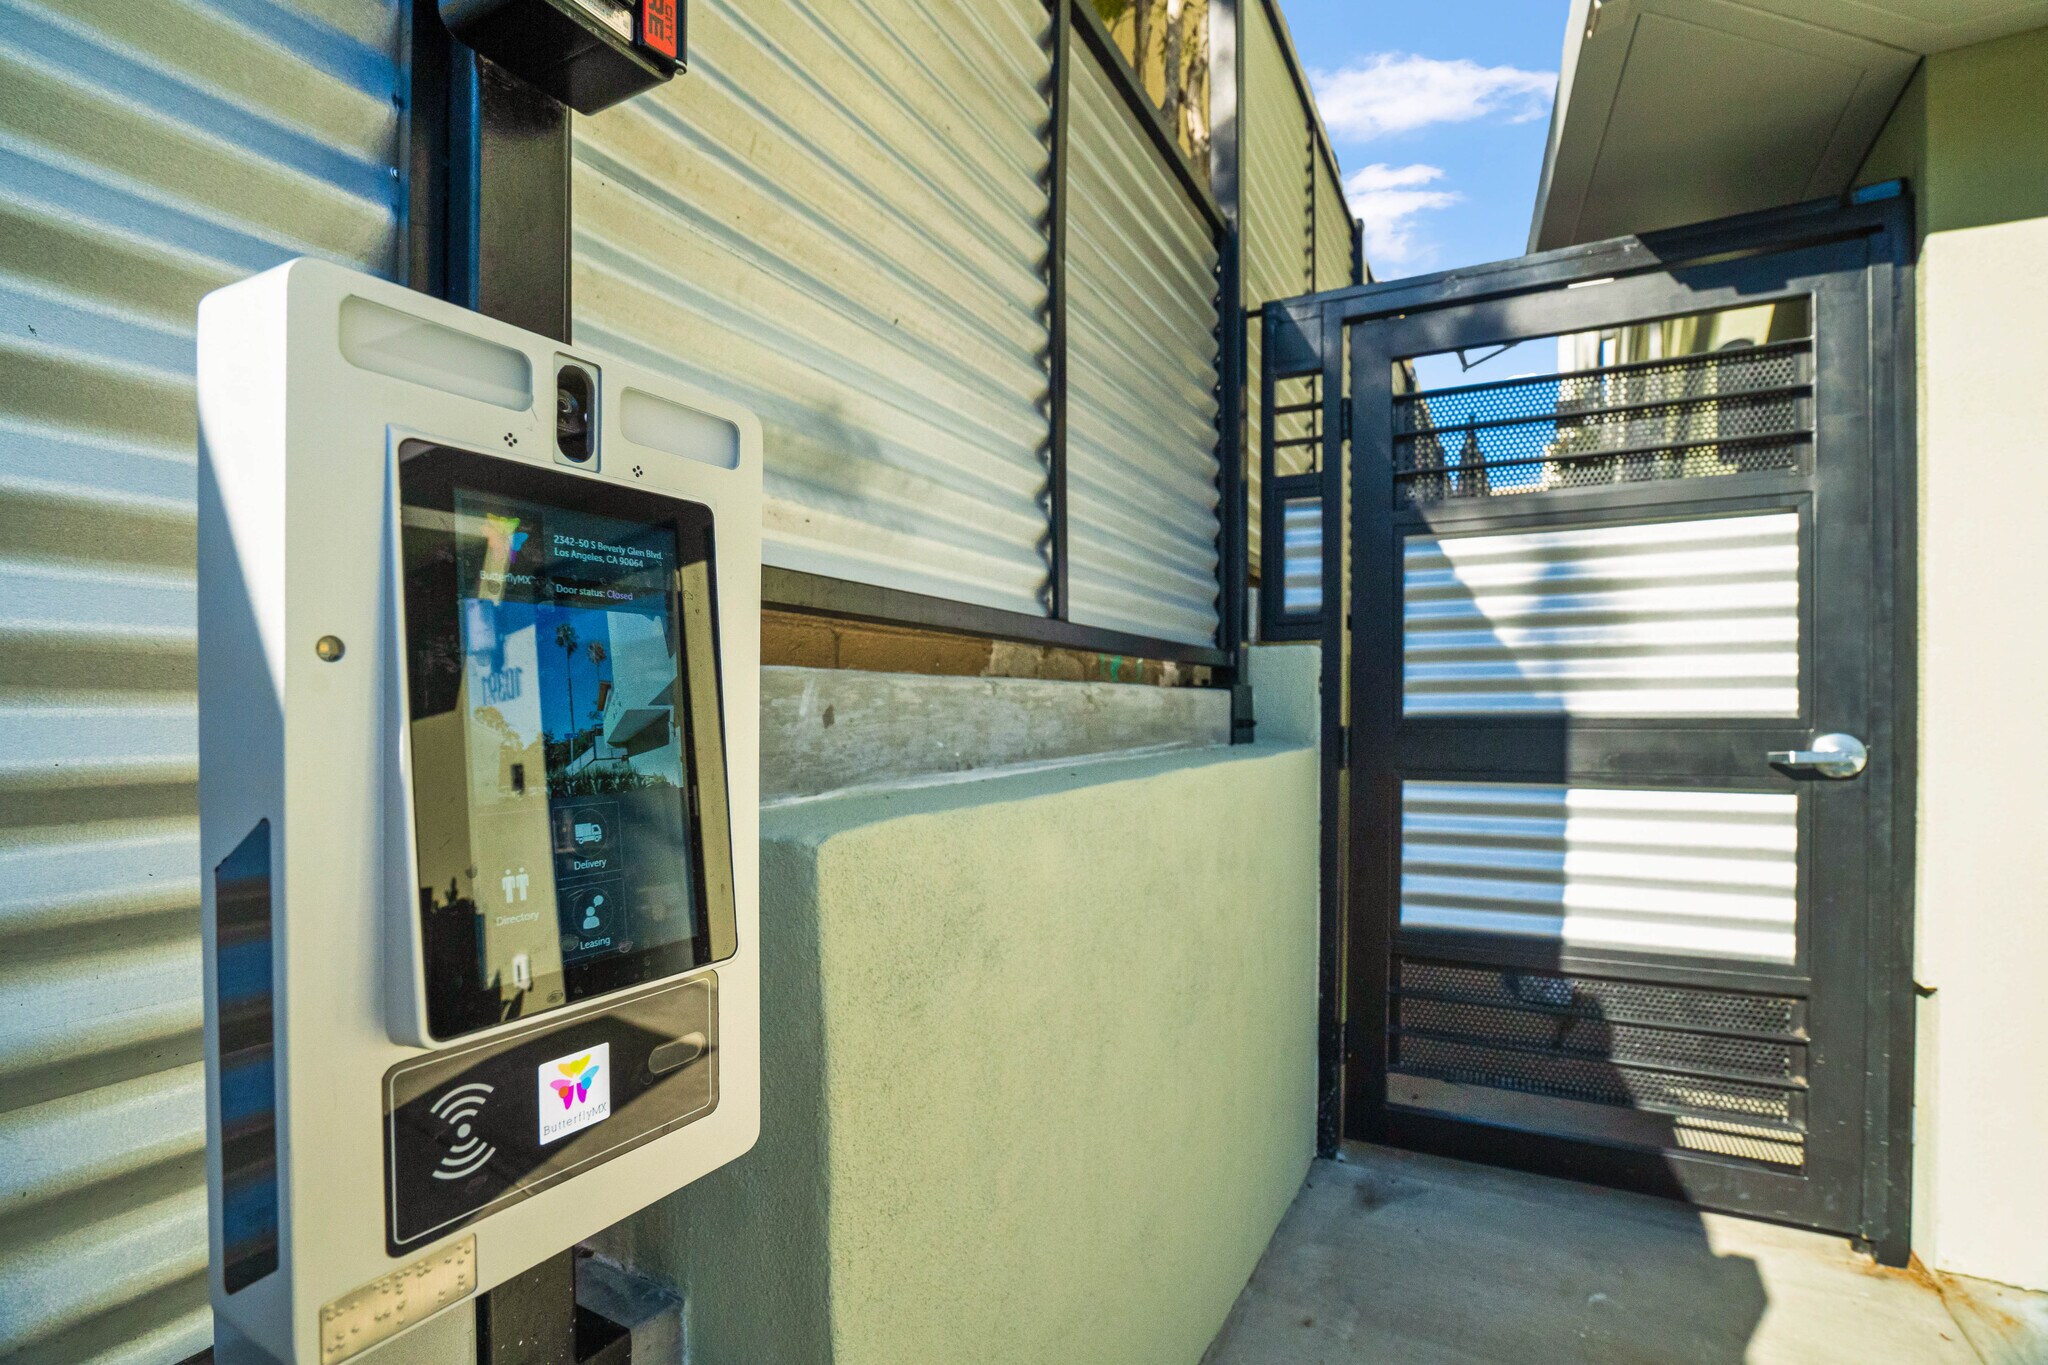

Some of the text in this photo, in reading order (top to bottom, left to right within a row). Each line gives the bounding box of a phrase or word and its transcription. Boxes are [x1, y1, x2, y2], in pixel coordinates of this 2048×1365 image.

[665, 5, 673, 46] CITY
[553, 534, 664, 560] 2342-50 S Beverly Glen Blvd.
[554, 547, 644, 568] Los Angeles, CA 90064
[556, 584, 634, 601] Door status: Closed
[573, 859, 607, 871] Delivery
[495, 911, 540, 927] Directory
[580, 937, 611, 950] Leasing
[543, 1102, 608, 1136] ButterflyMX
